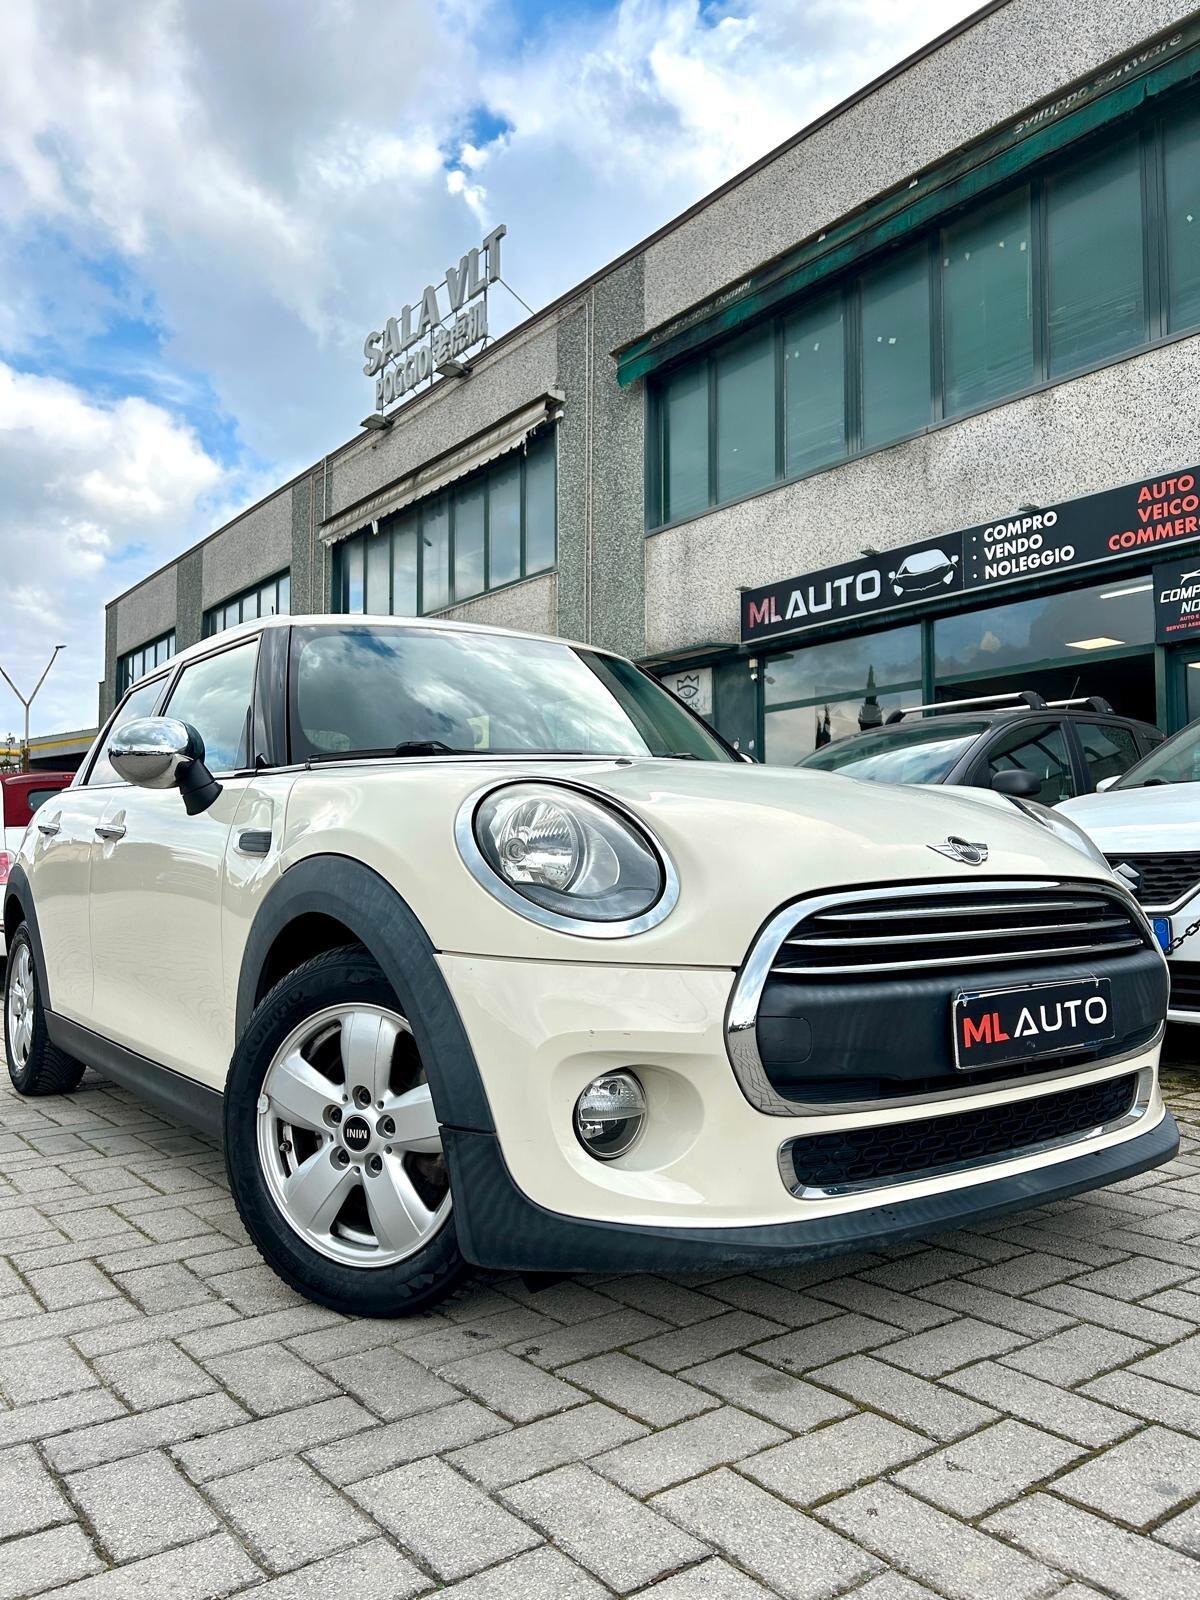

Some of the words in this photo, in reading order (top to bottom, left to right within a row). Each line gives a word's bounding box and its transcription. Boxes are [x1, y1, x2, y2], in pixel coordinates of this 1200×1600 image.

[363, 285, 440, 377] SALA
[445, 223, 507, 312] VLT
[375, 345, 432, 411] POGGIO
[1137, 474, 1195, 504] AUTO
[1137, 494, 1199, 523] VEICO
[983, 511, 1058, 542] COMPRO
[1108, 515, 1200, 551] COMMER
[983, 534, 1043, 560] VENDO
[984, 545, 1075, 580] NOLEGGIO
[346, 1128, 368, 1139] MINI
